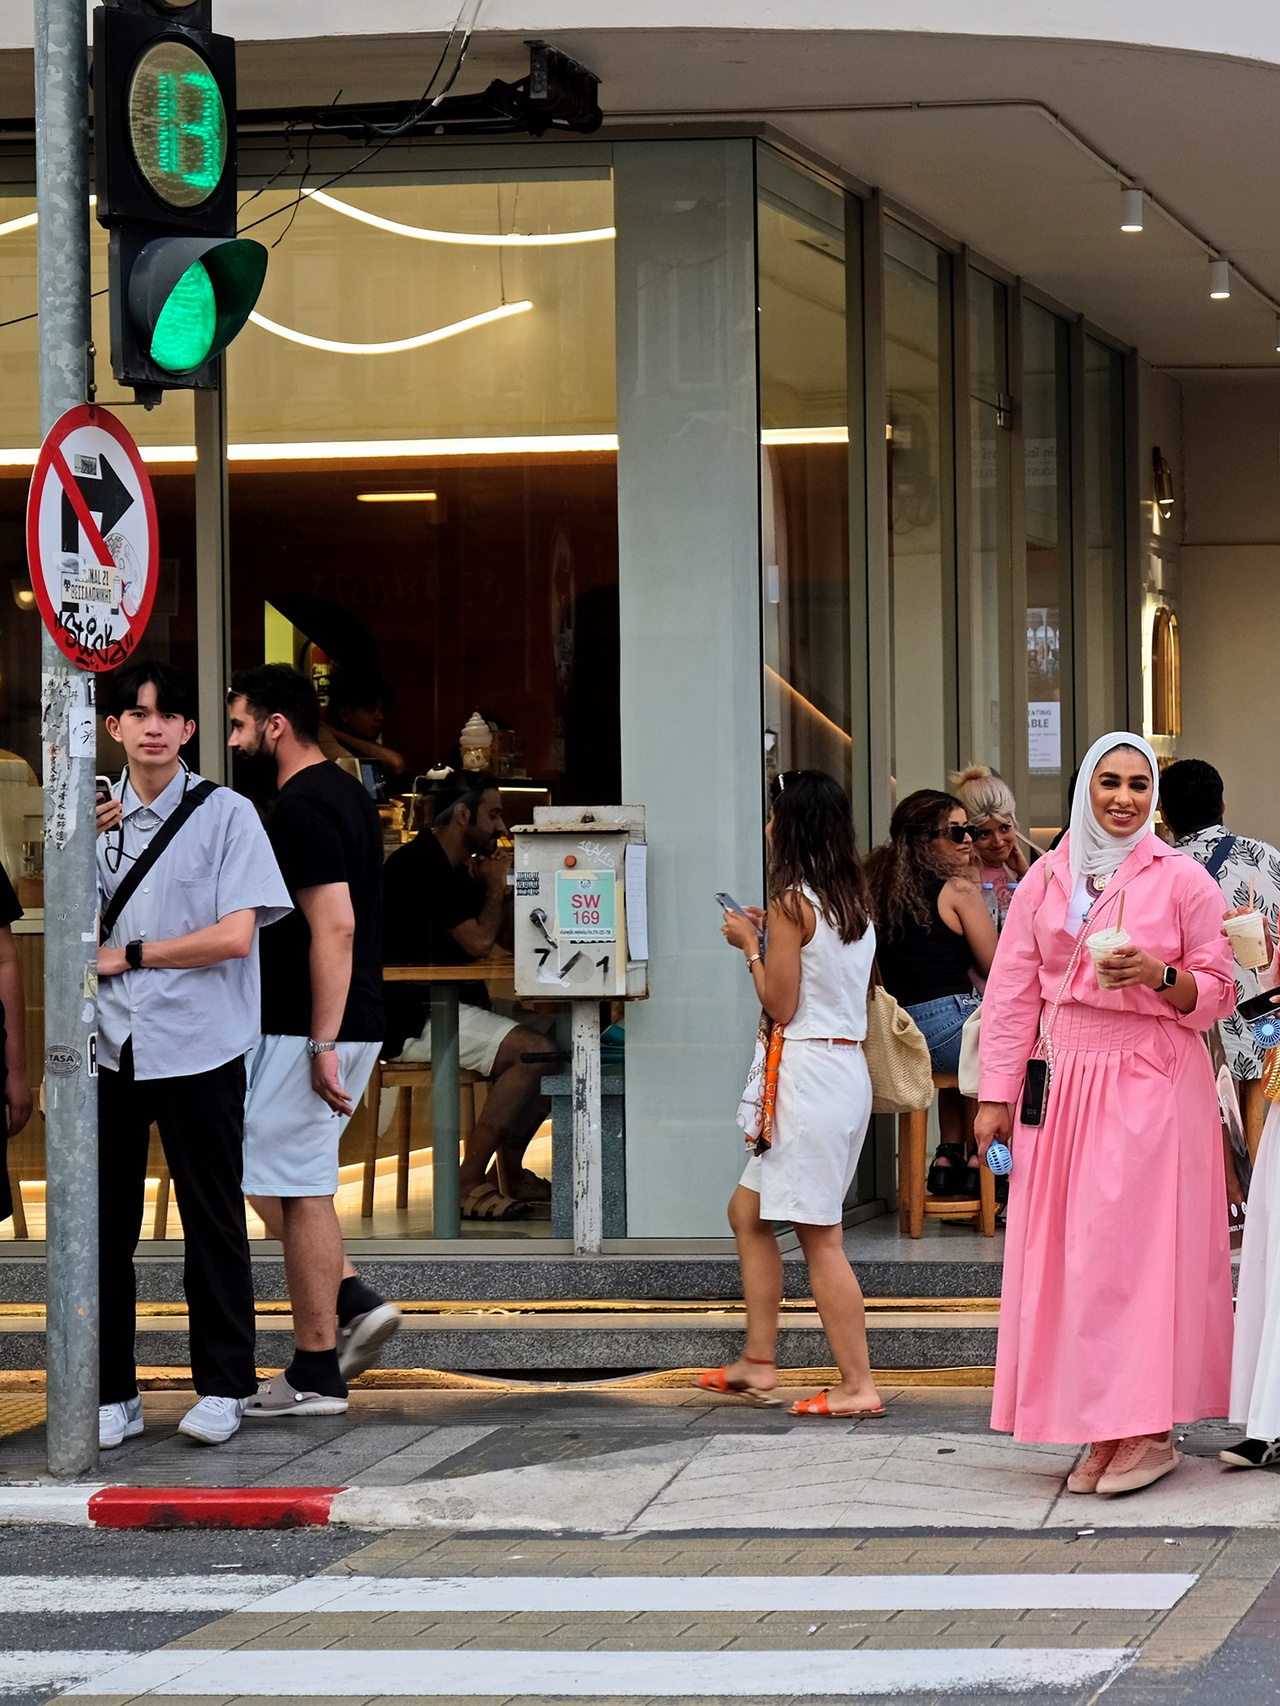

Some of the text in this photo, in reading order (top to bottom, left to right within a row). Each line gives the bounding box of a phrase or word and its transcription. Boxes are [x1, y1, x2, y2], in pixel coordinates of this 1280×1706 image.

[571, 894, 601, 909] SW
[572, 910, 600, 925] 169
[49, 1054, 74, 1062] TASA
